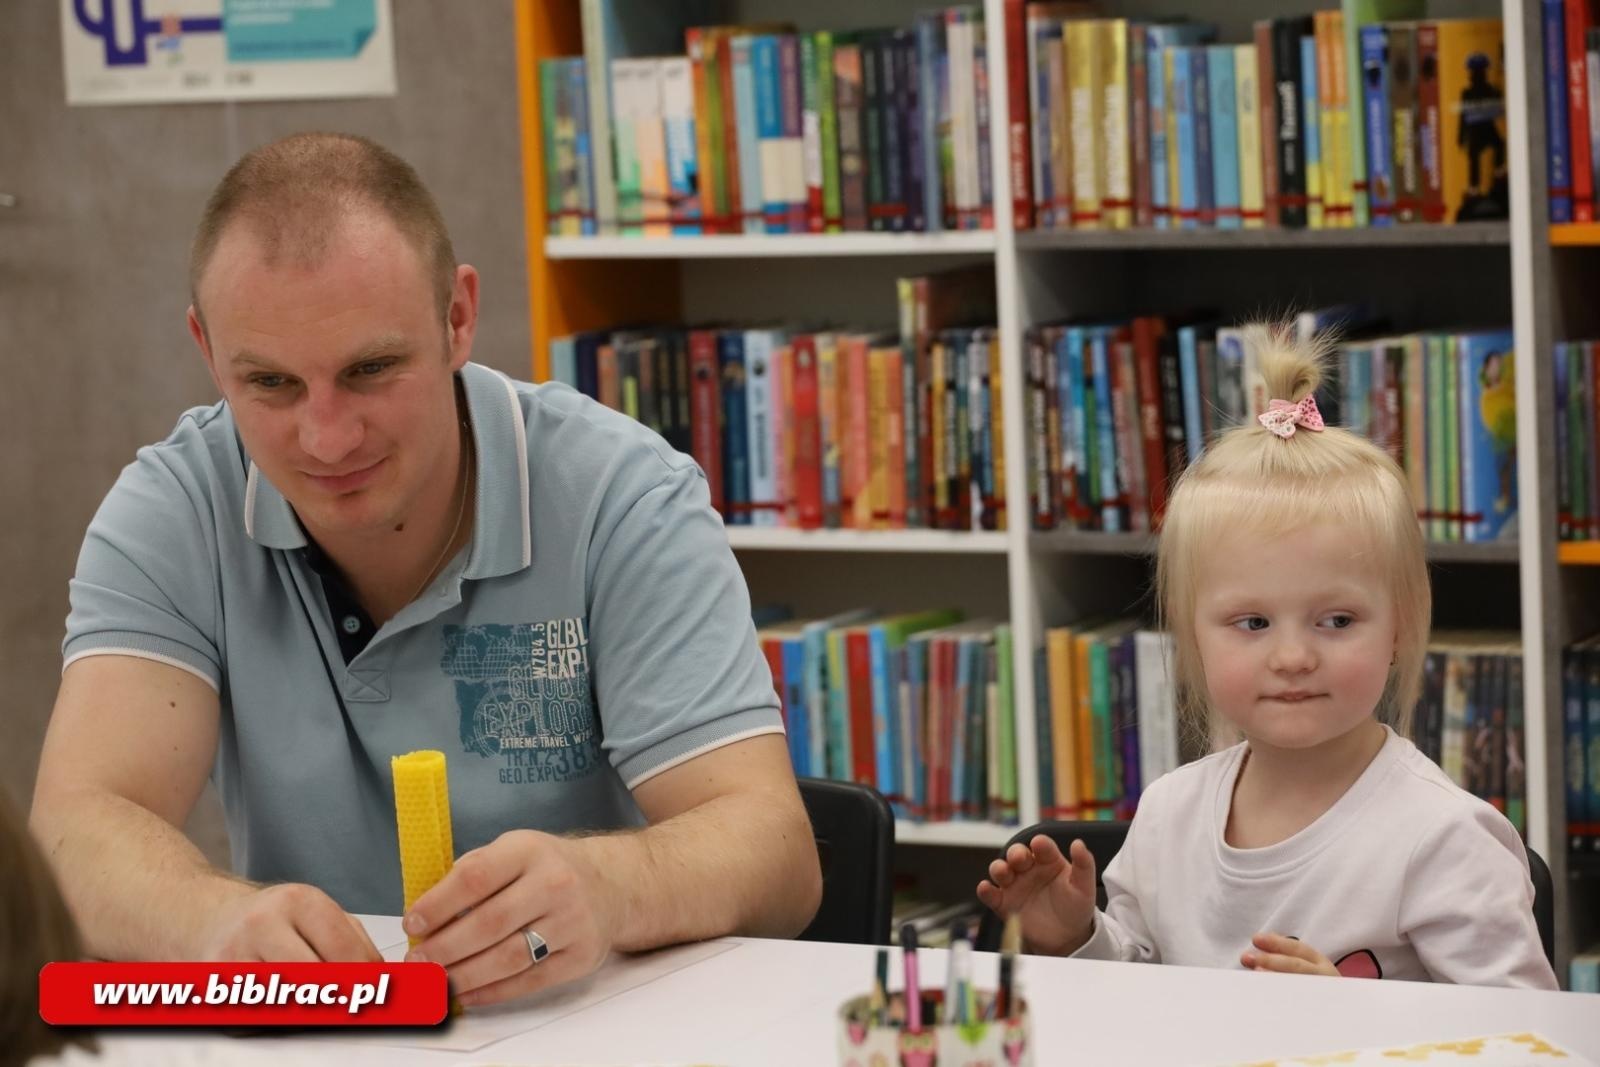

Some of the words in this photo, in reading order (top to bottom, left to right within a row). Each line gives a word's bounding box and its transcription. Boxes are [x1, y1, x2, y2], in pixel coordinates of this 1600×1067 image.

[531, 623, 546, 679] W784.5
[500, 735, 538, 749] EXTREME
[540, 735, 571, 748] TRAVEL
